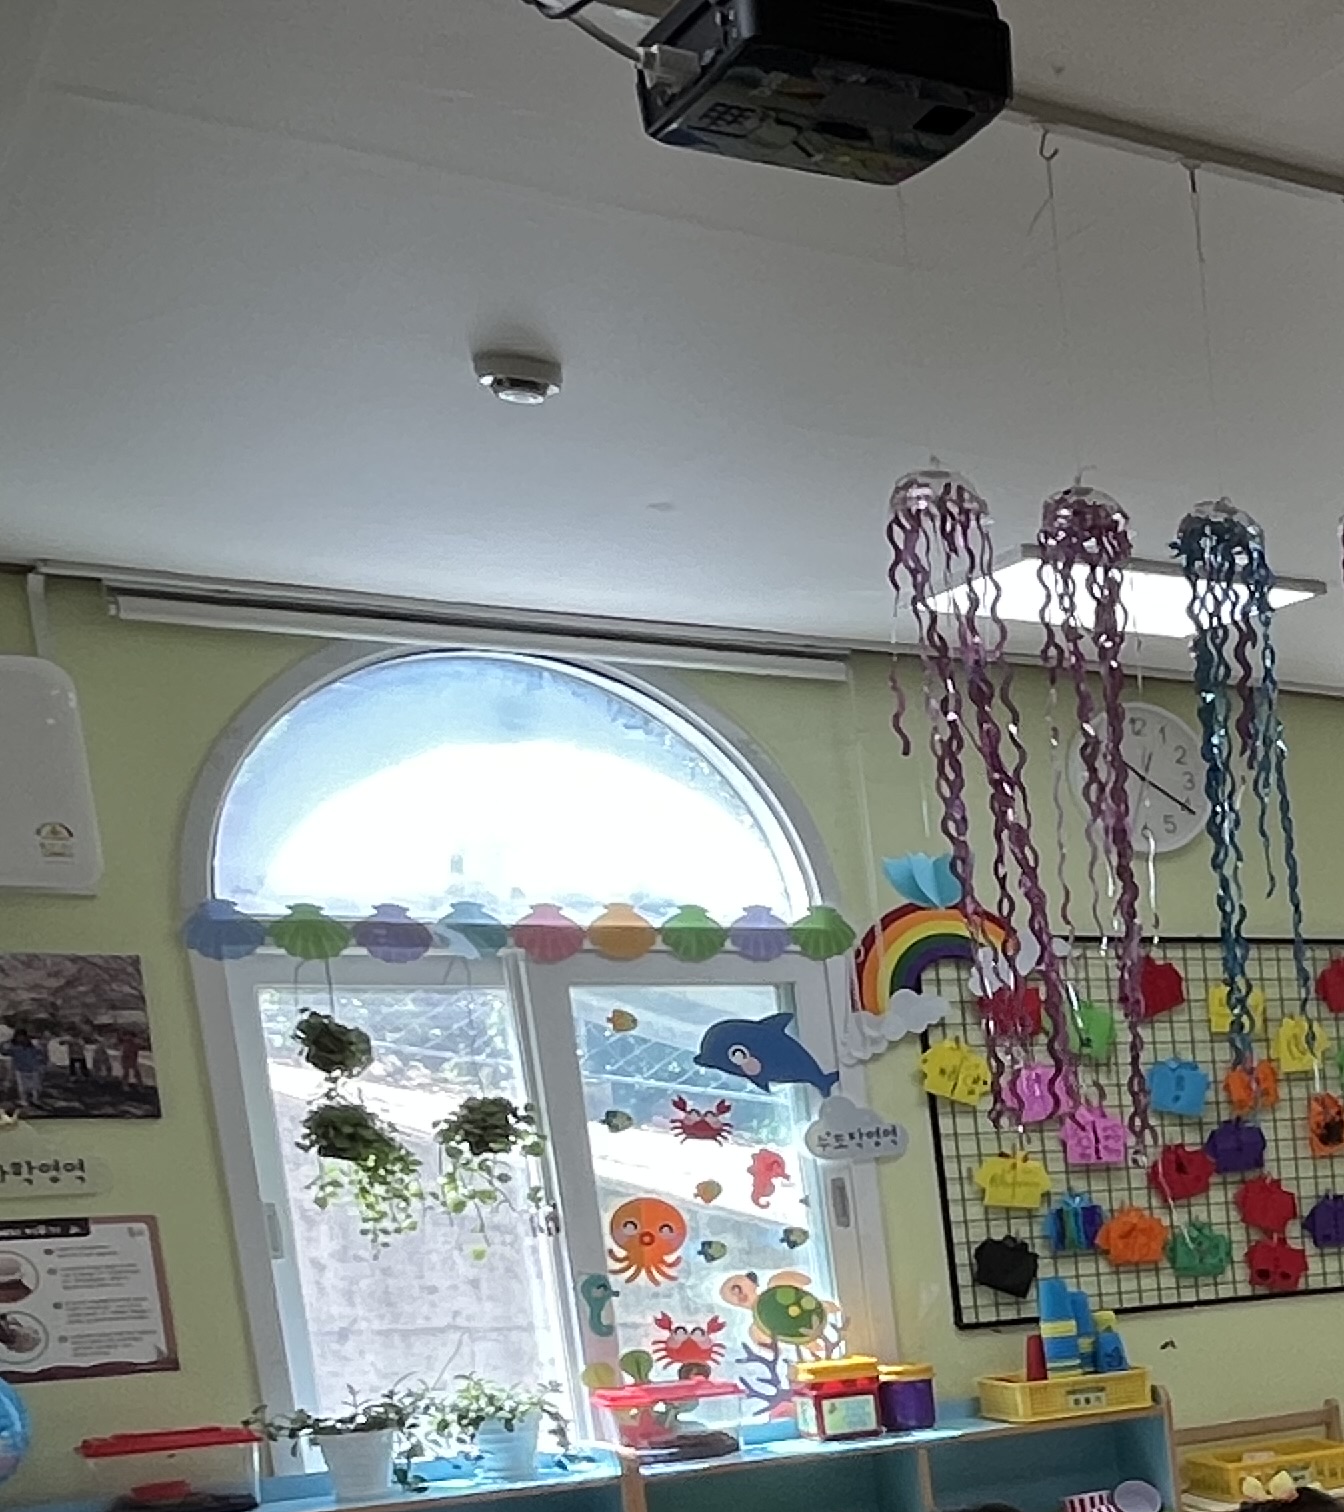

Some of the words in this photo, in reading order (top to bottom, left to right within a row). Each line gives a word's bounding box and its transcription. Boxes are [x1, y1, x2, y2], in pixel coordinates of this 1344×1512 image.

[1129, 716, 1147, 736] 12
[1174, 744, 1188, 765] 2
[1181, 770, 1196, 791] 3
[1162, 814, 1178, 834] 5
